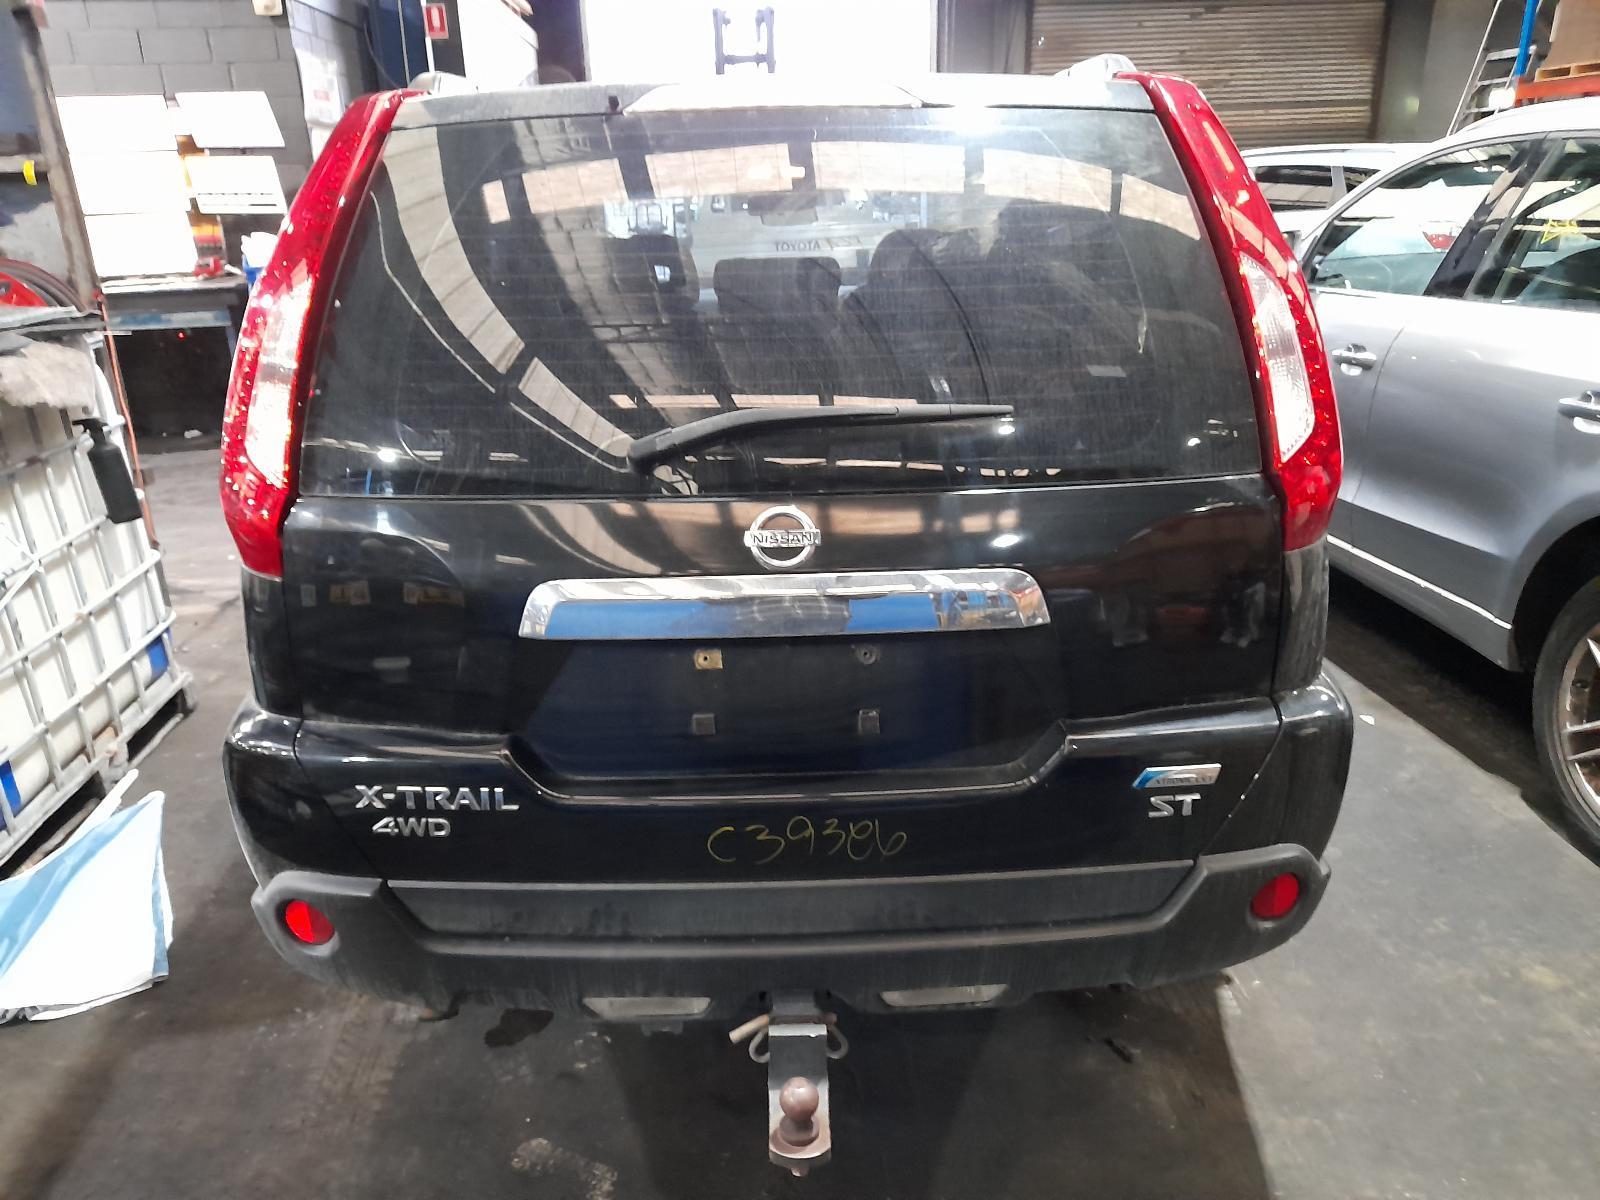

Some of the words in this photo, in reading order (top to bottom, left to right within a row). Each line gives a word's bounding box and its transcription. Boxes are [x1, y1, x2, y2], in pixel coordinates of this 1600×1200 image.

[753, 532, 814, 544] NISSAN
[355, 784, 520, 811] X-TRAIL
[1148, 792, 1202, 818] ST
[372, 816, 451, 838] 4WD
